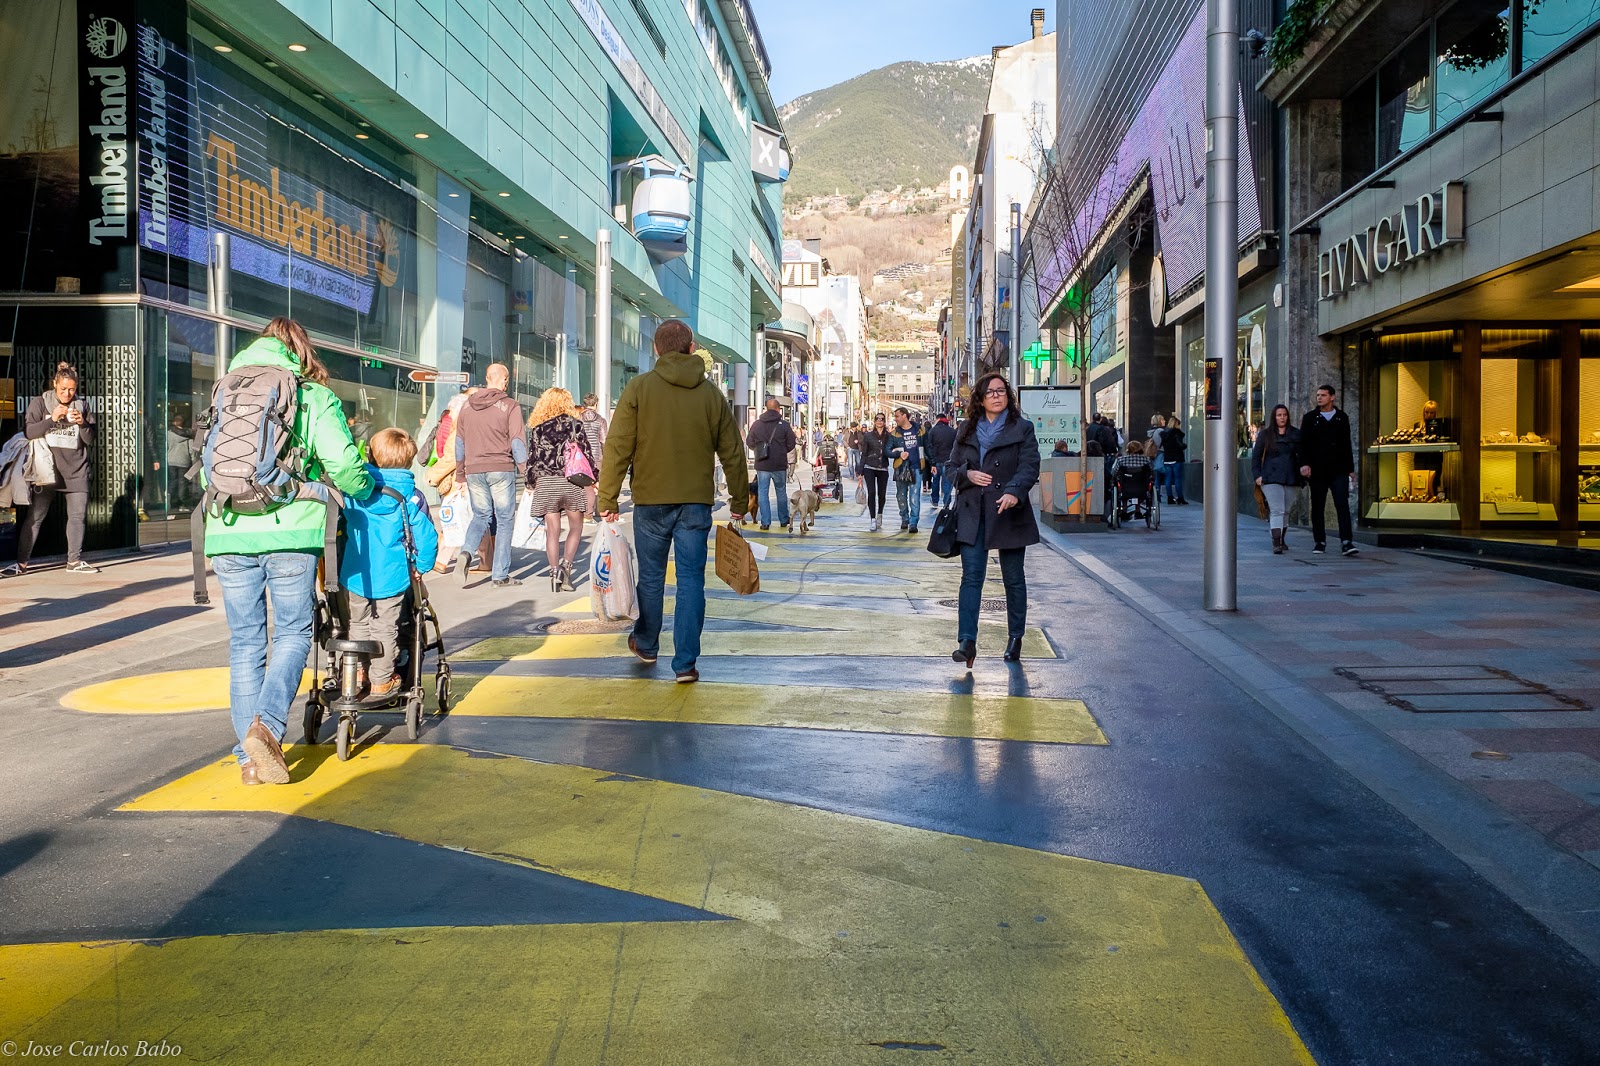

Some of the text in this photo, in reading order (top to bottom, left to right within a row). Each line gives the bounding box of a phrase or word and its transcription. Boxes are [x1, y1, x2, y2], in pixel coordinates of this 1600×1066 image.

[88, 66, 127, 245] Timberland
[143, 70, 167, 248] Timberland
[207, 131, 368, 277] Timberland
[1317, 180, 1458, 301] HVNGARI
[16, 345, 136, 361] DIRK BIKKEMBERGS
[16, 361, 136, 379] DIRK BEMBERGS
